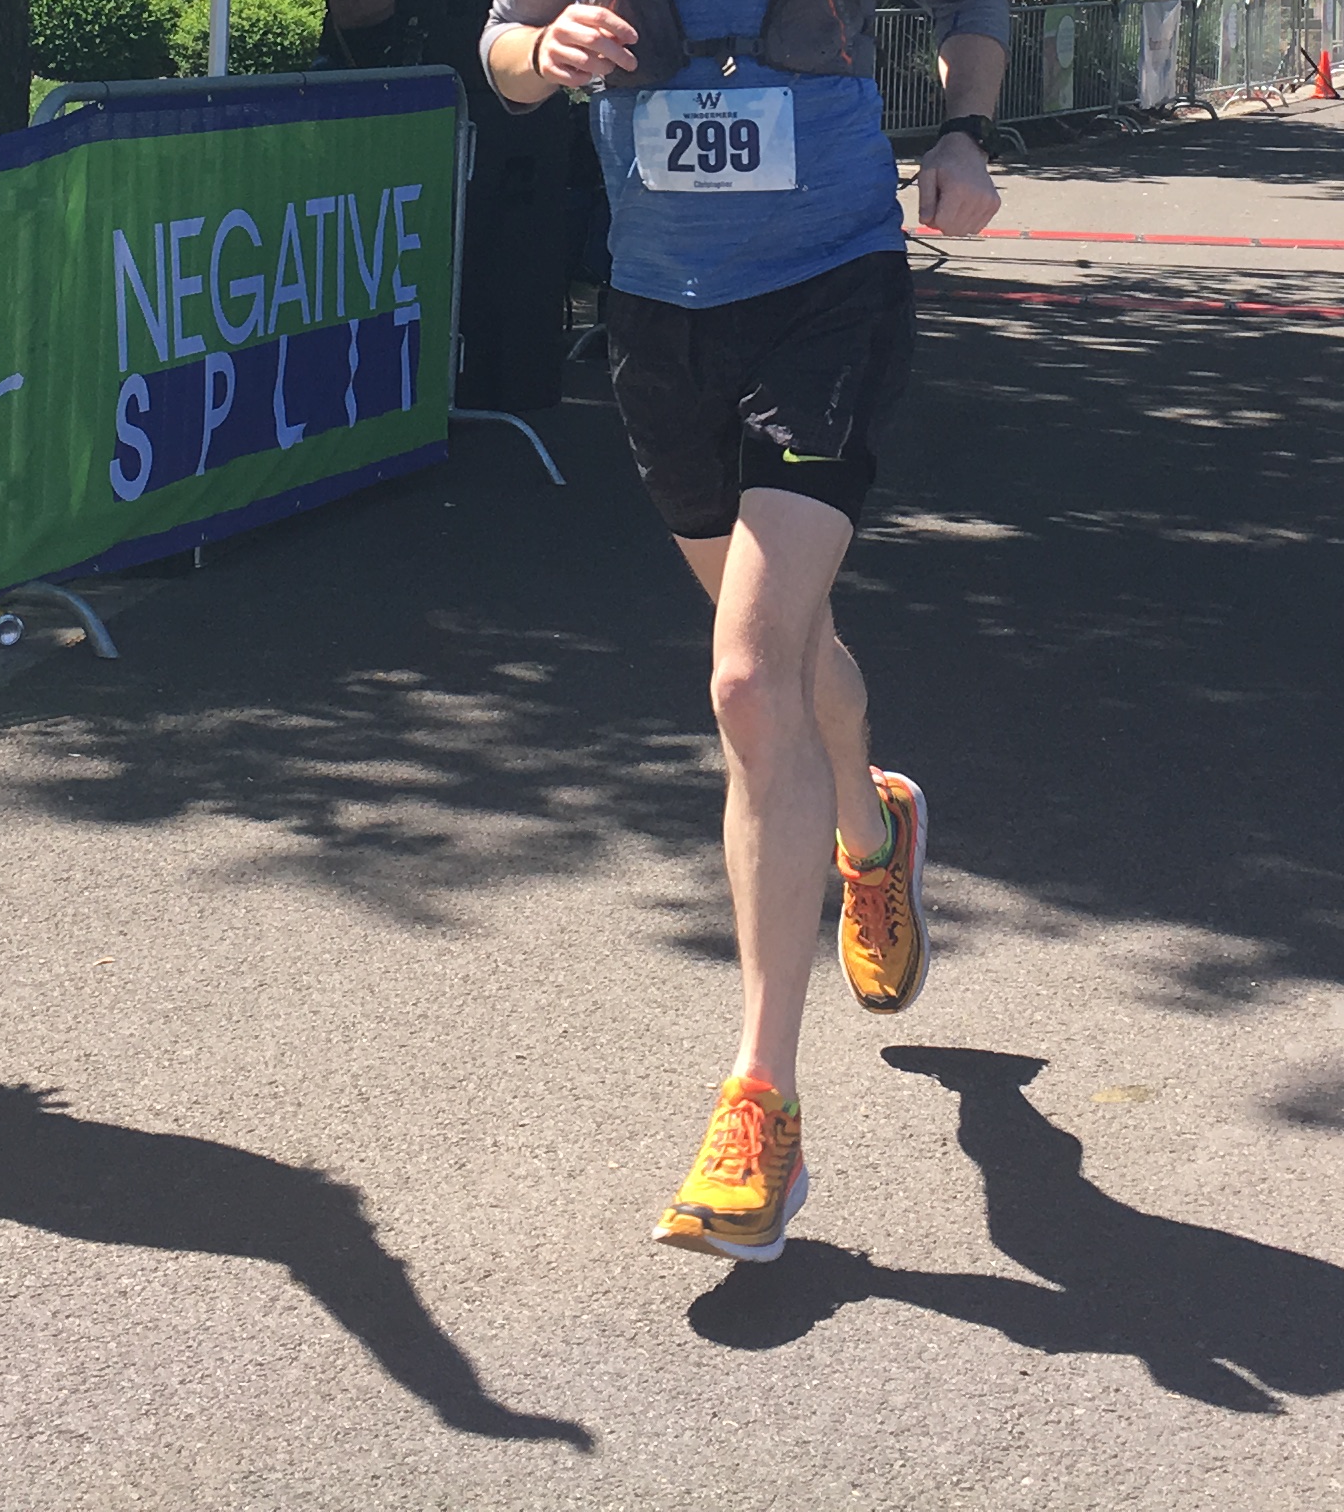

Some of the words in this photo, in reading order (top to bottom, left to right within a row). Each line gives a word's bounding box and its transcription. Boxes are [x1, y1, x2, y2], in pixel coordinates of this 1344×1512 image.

[666, 119, 761, 173] 299
[113, 184, 423, 372] NEGATIVE
[109, 302, 421, 502] SPLIT
